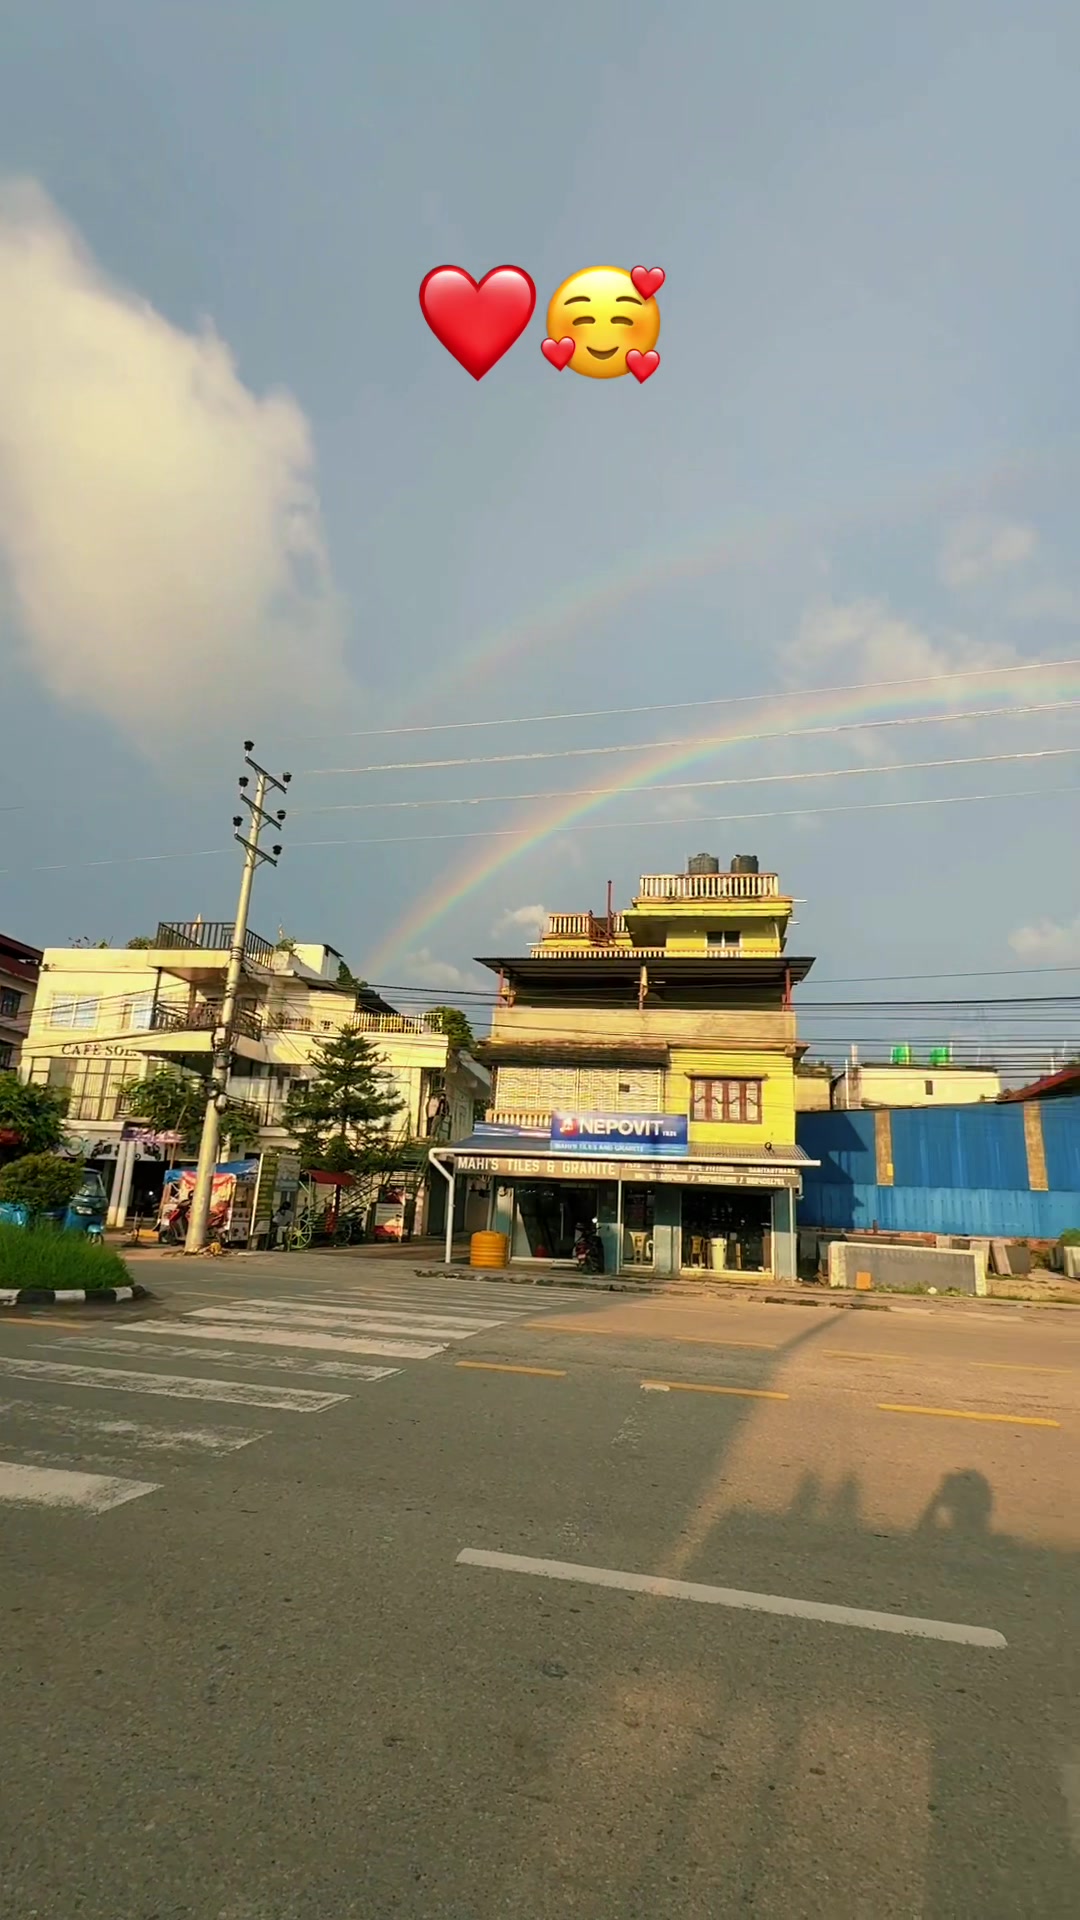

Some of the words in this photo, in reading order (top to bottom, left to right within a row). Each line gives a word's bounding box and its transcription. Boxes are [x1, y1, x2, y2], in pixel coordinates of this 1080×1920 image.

[61, 1043, 101, 1056] CAFE
[579, 1118, 664, 1136] NEPOVIT
[457, 1156, 499, 1171] MAHI'S
[507, 1158, 540, 1173] TILES
[547, 1161, 555, 1174] &
[562, 1160, 616, 1176] GRANITE
